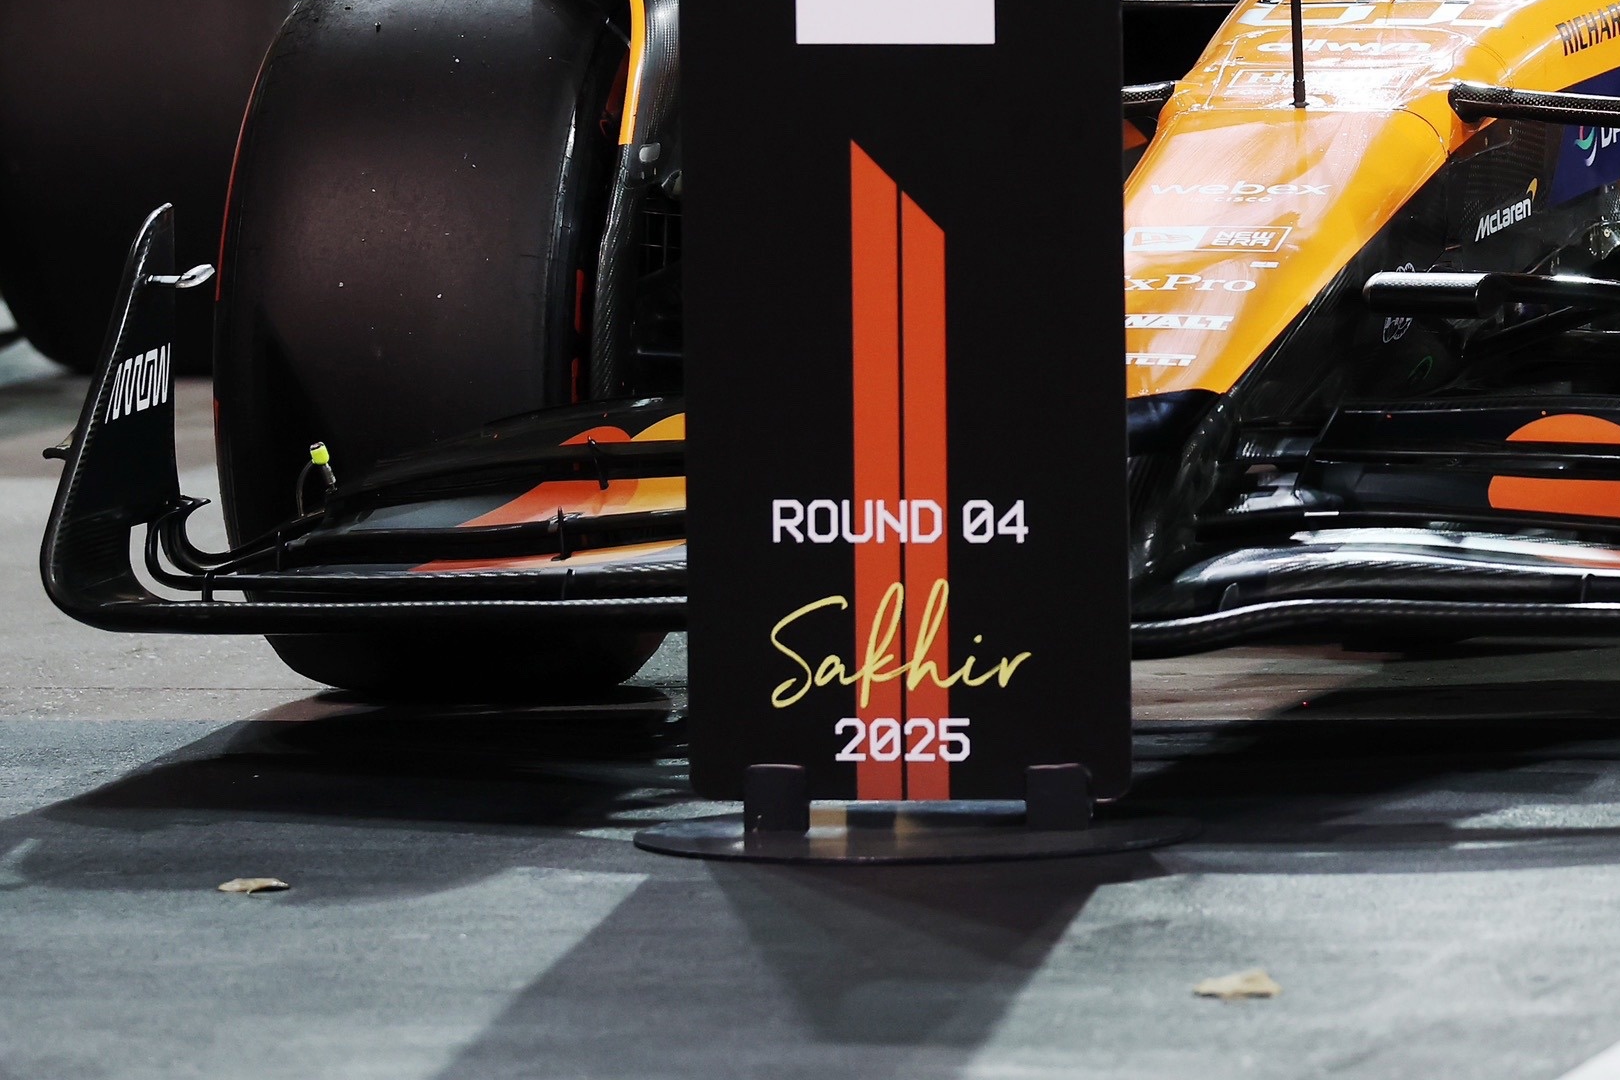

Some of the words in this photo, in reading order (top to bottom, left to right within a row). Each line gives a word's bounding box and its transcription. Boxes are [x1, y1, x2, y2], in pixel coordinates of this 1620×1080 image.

[1151, 180, 1333, 196] webex
[1215, 230, 1277, 240] NEW
[1474, 198, 1532, 243] McLaren
[1210, 237, 1272, 247] ERA
[1125, 274, 1257, 292] xPro
[772, 499, 944, 544] ROUND
[962, 499, 1030, 544] 04
[770, 577, 1033, 709] Sakhir
[834, 717, 972, 762] 2025
